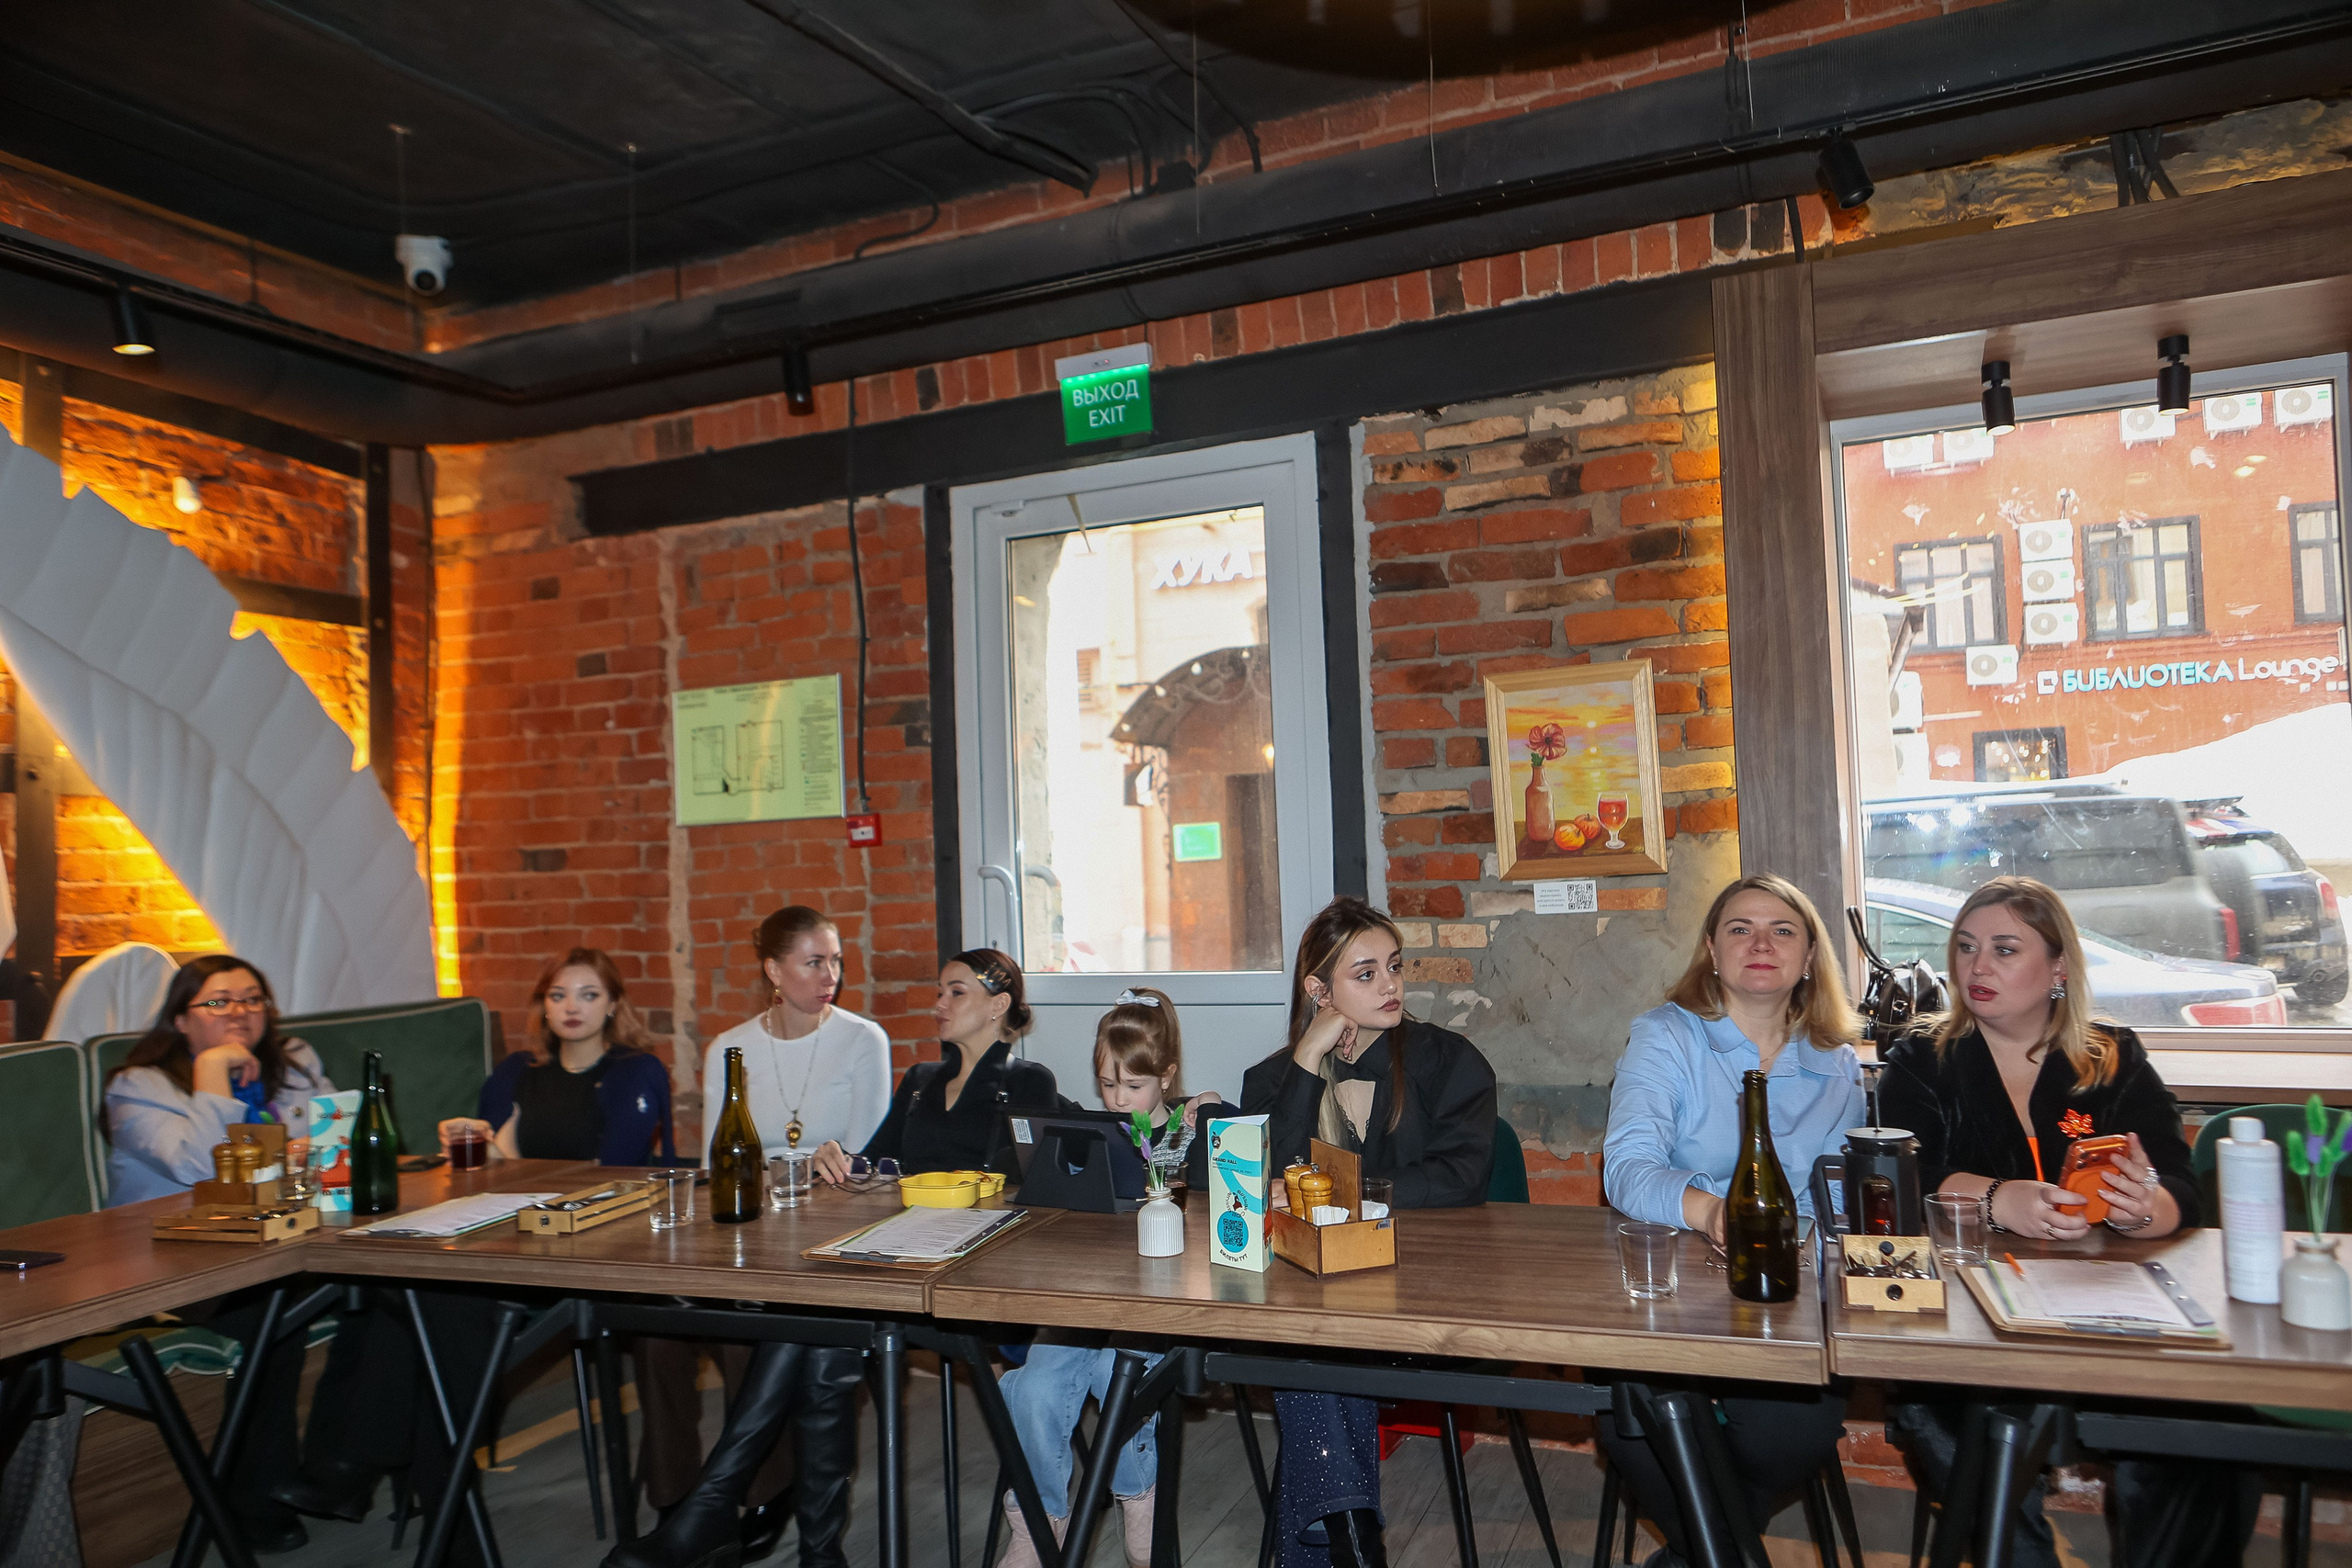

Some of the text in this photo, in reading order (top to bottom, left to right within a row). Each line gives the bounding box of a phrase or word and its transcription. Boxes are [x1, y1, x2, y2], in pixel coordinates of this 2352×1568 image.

[1072, 378, 1139, 407] ВЫХОД
[1089, 405, 1125, 427] EXIT
[1150, 548, 1253, 590] ХУКА
[2063, 656, 2339, 693] БИБЛИОТЕКА Lounge
[1219, 1248, 1248, 1262] БИЛЕТЫ ТУТ
